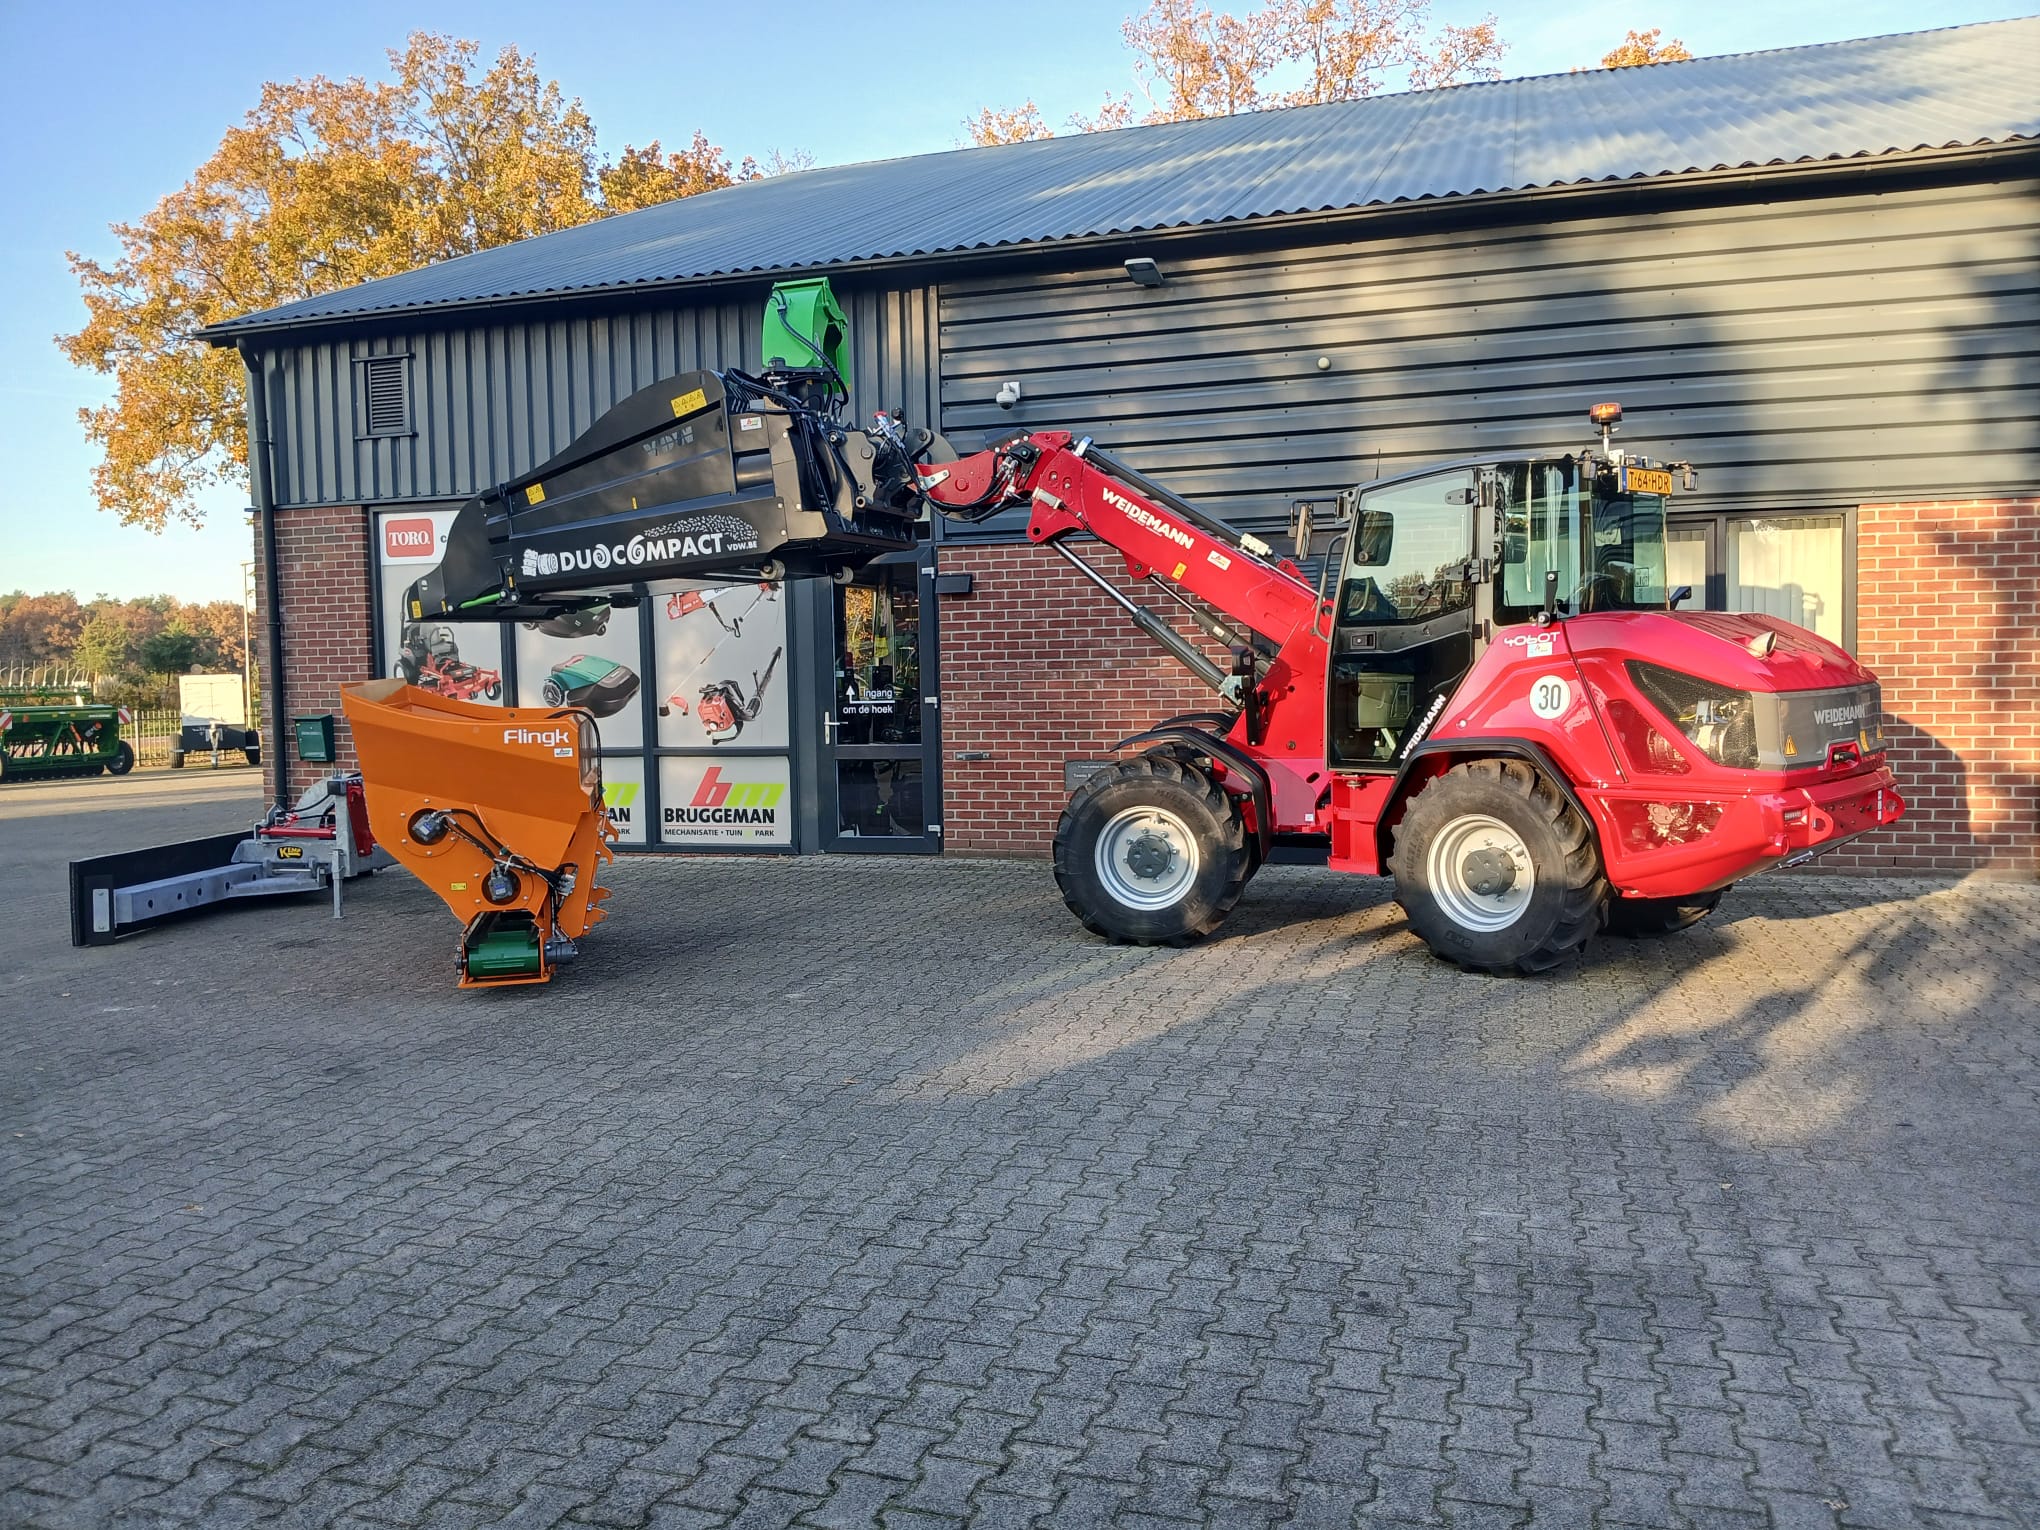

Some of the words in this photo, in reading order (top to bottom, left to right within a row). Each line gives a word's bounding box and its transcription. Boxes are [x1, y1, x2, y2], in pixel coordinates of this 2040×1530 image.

[1102, 487, 1195, 550] WEIDEMANN
[559, 532, 724, 572] DUOCOMPACT
[726, 540, 758, 552] VDW.BE
[863, 689, 893, 699] Ingang
[1538, 683, 1562, 711] 30
[842, 706, 857, 714] om
[858, 705, 870, 714] de
[871, 704, 894, 714] hoek
[1813, 704, 1867, 725] WEIDEMANN
[1400, 693, 1447, 760] WEIDEMANN
[503, 728, 569, 747] Flingk
[664, 807, 775, 824] BRUGGEMAN
[664, 828, 719, 837] MECHANISATIE
[726, 828, 743, 837] TUIN
[755, 828, 775, 837] PARK
